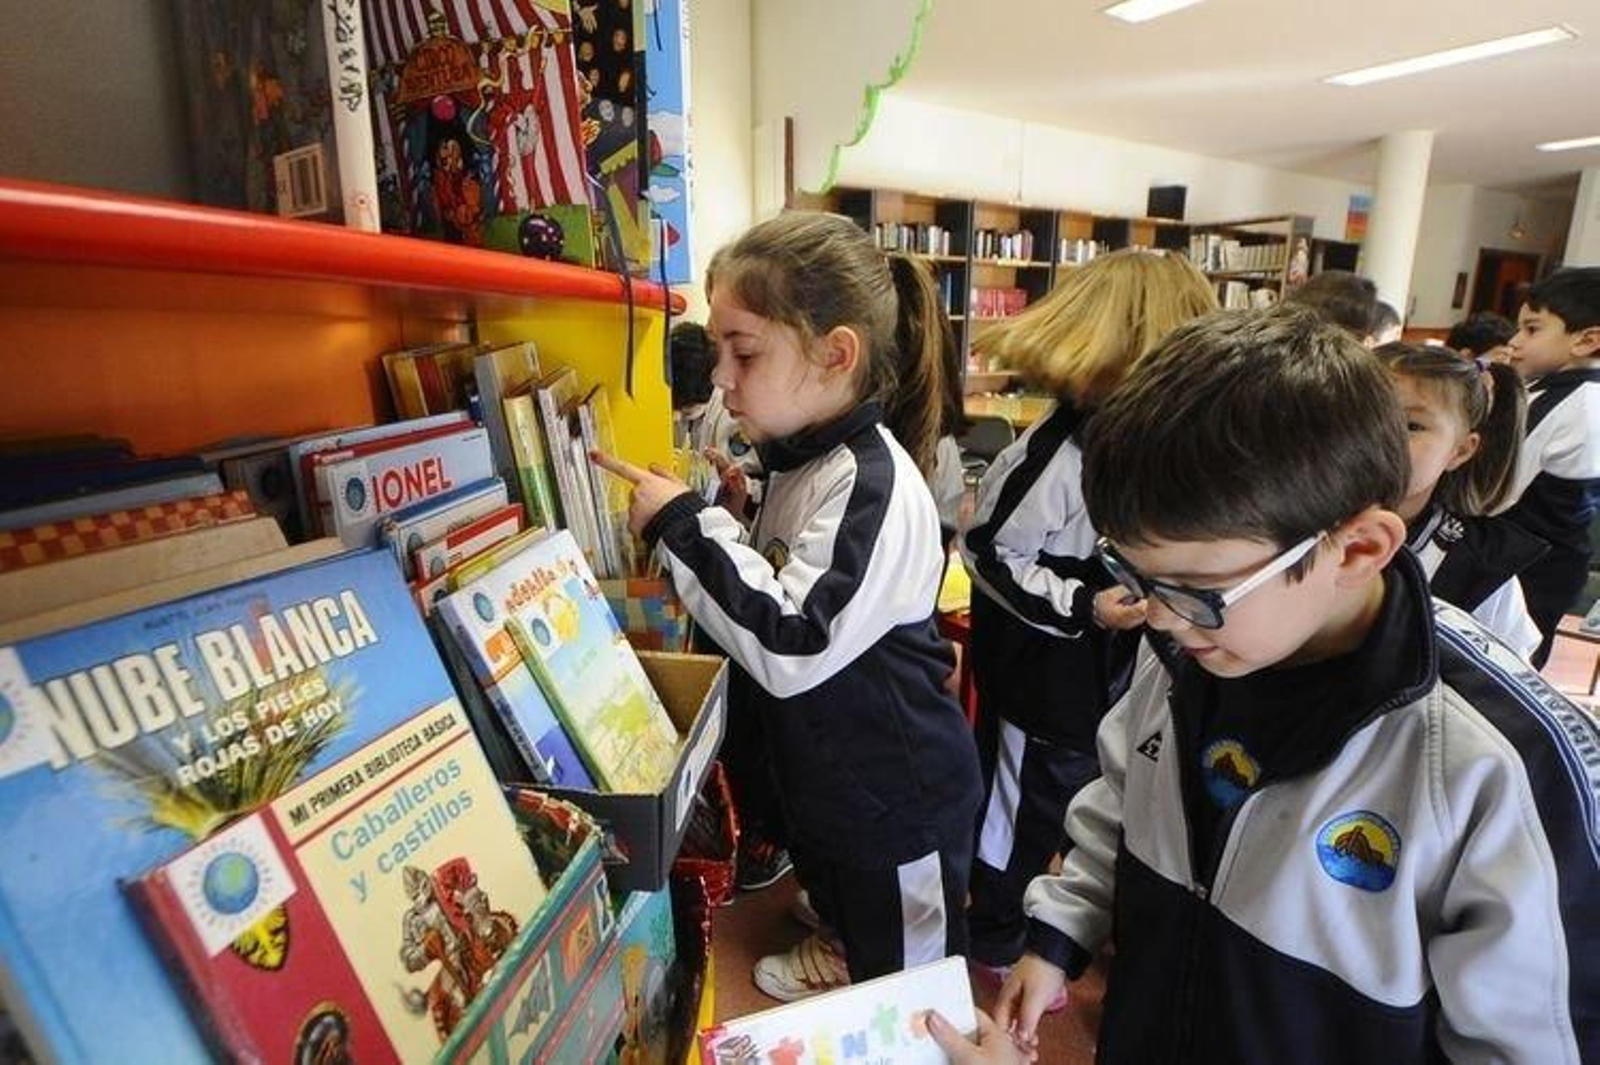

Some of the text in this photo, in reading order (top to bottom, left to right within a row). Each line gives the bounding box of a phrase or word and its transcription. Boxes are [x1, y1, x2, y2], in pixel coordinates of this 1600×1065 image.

[34, 588, 378, 771] NUBE BLANCA
[171, 677, 328, 754] Y LOS PIELES
[176, 696, 343, 787] ROJAS DE HOY
[288, 801, 311, 828] MI
[309, 770, 365, 814] PRIMERA
[363, 732, 422, 779] BIBLIOTECA
[330, 757, 463, 861] Caballeros
[350, 789, 475, 904] y castillos
